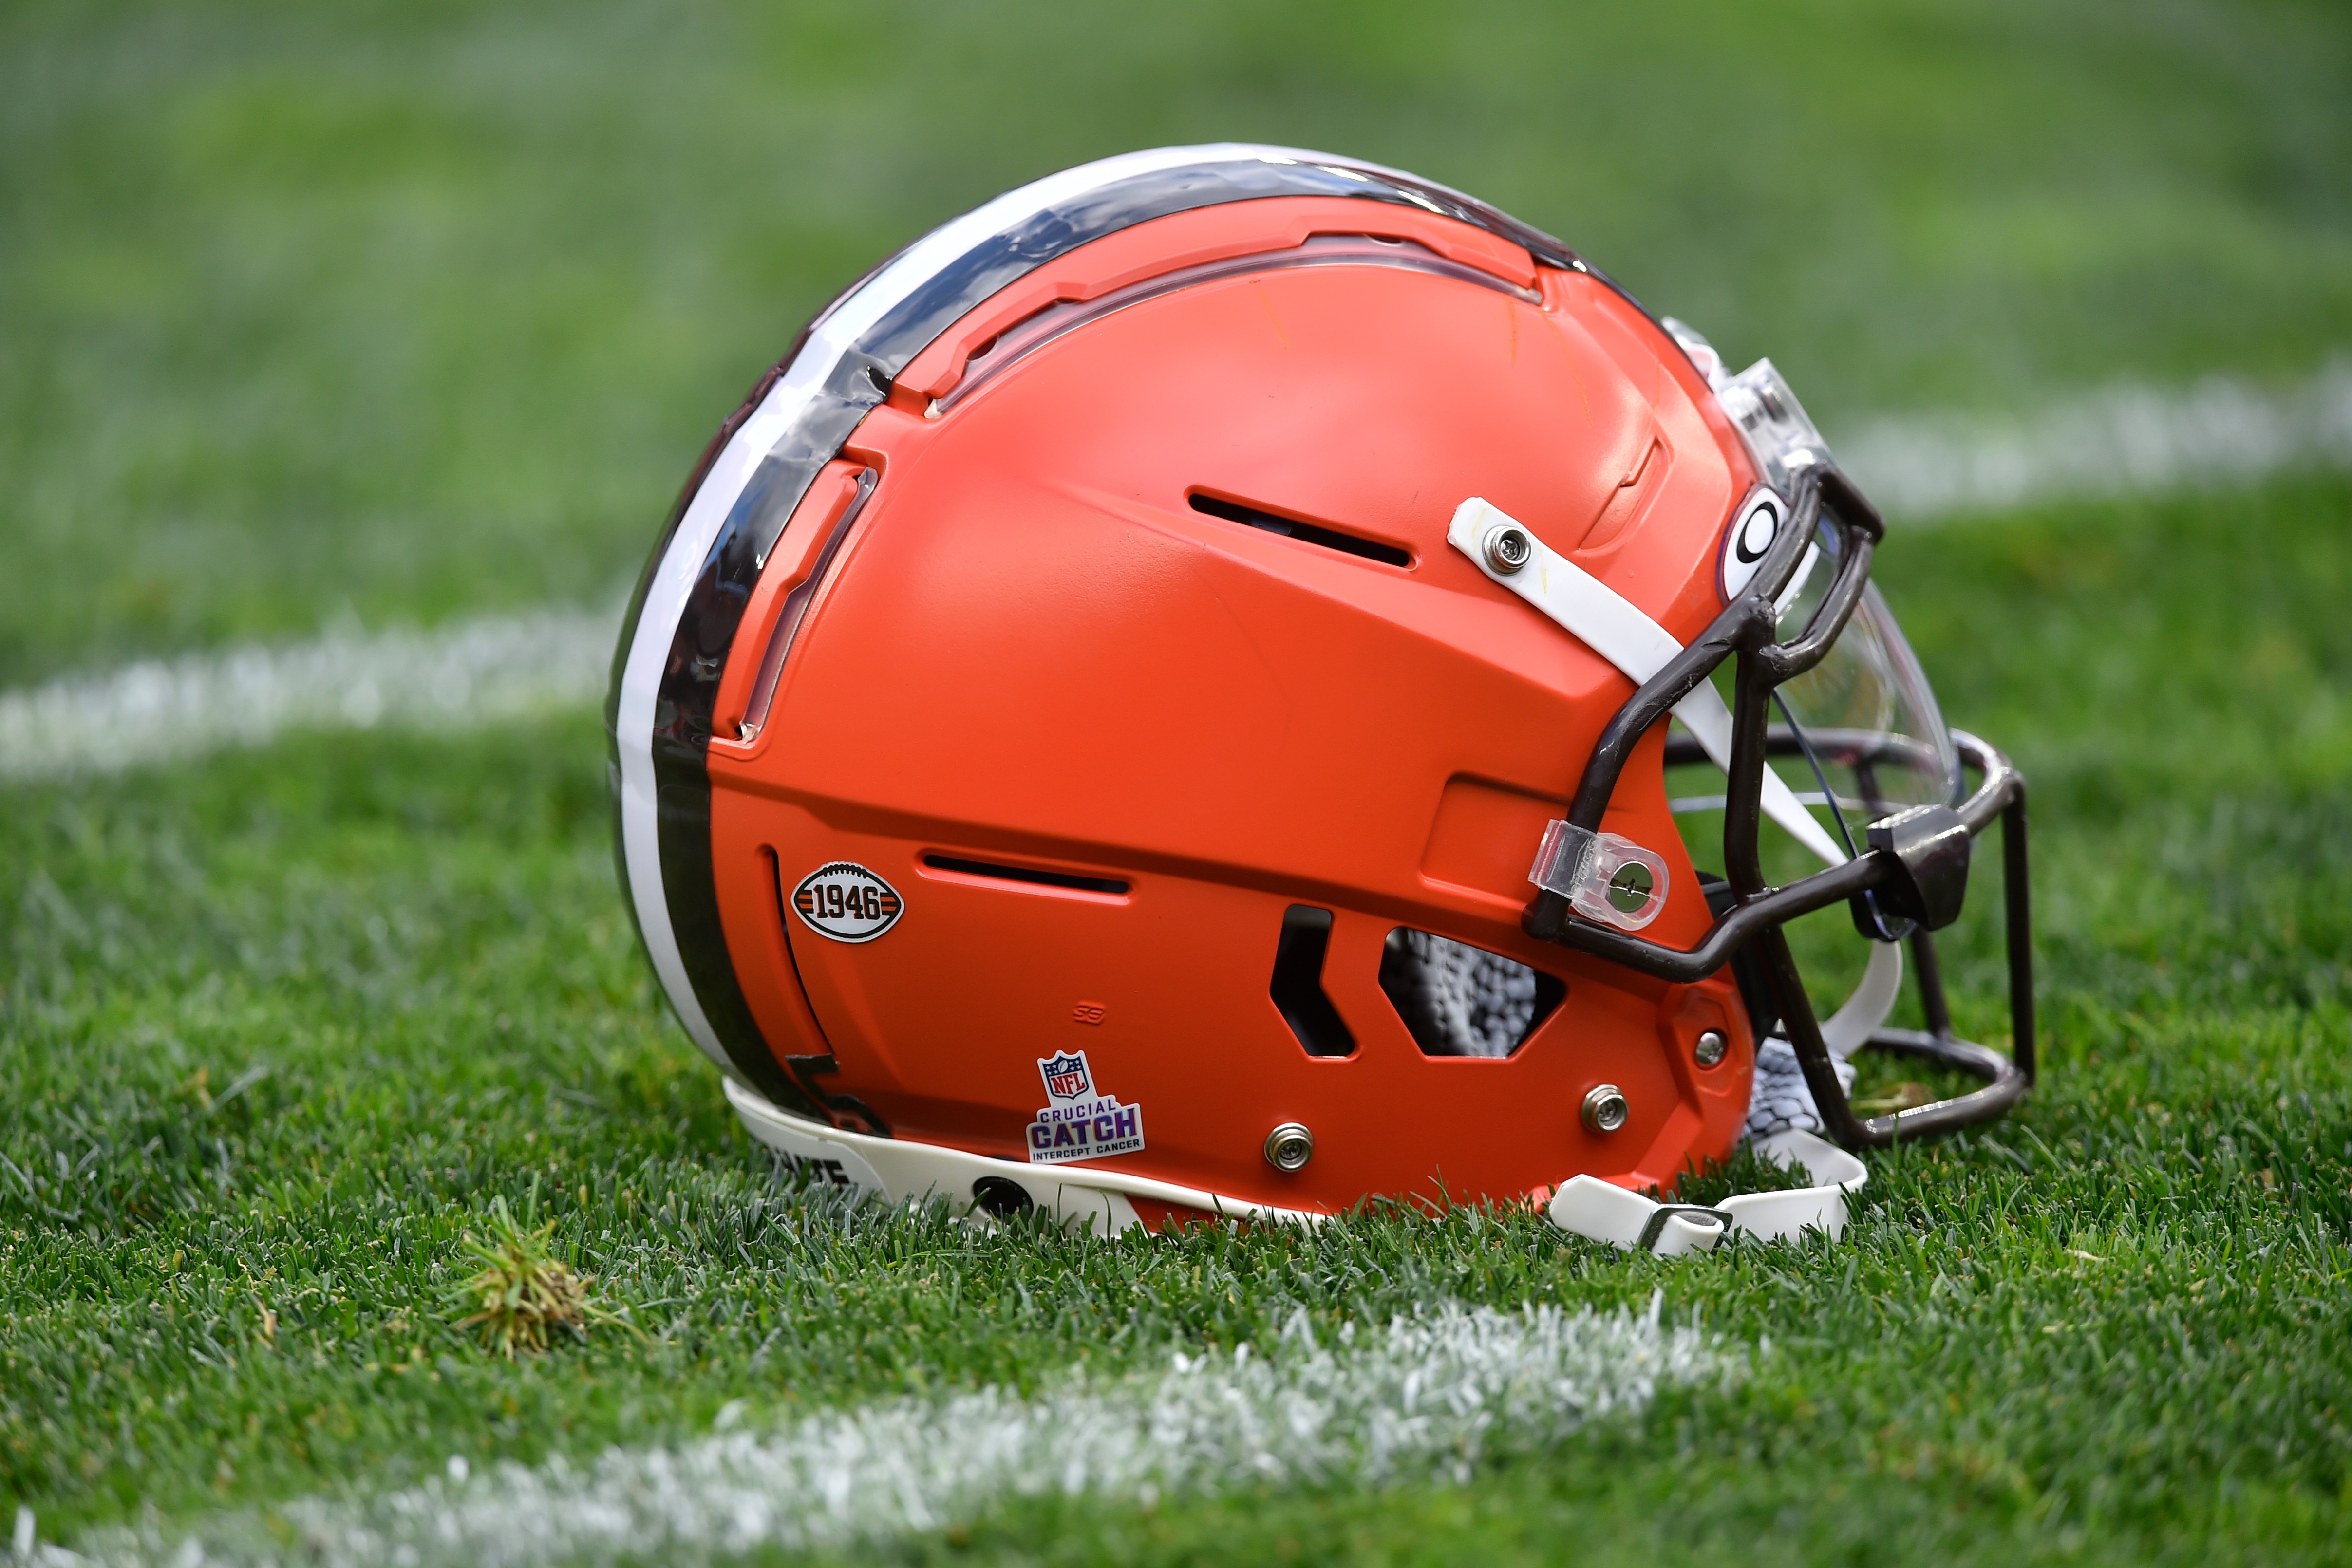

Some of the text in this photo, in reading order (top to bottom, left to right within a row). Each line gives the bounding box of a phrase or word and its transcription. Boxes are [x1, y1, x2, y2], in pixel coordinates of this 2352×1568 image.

[813, 884, 880, 920] 1946
[1051, 1072, 1086, 1095] NFL
[1040, 1099, 1116, 1123] CRUCIAL
[1030, 1108, 1137, 1149] CATCH
[1033, 1139, 1139, 1160] INTERCEPT CANCER
